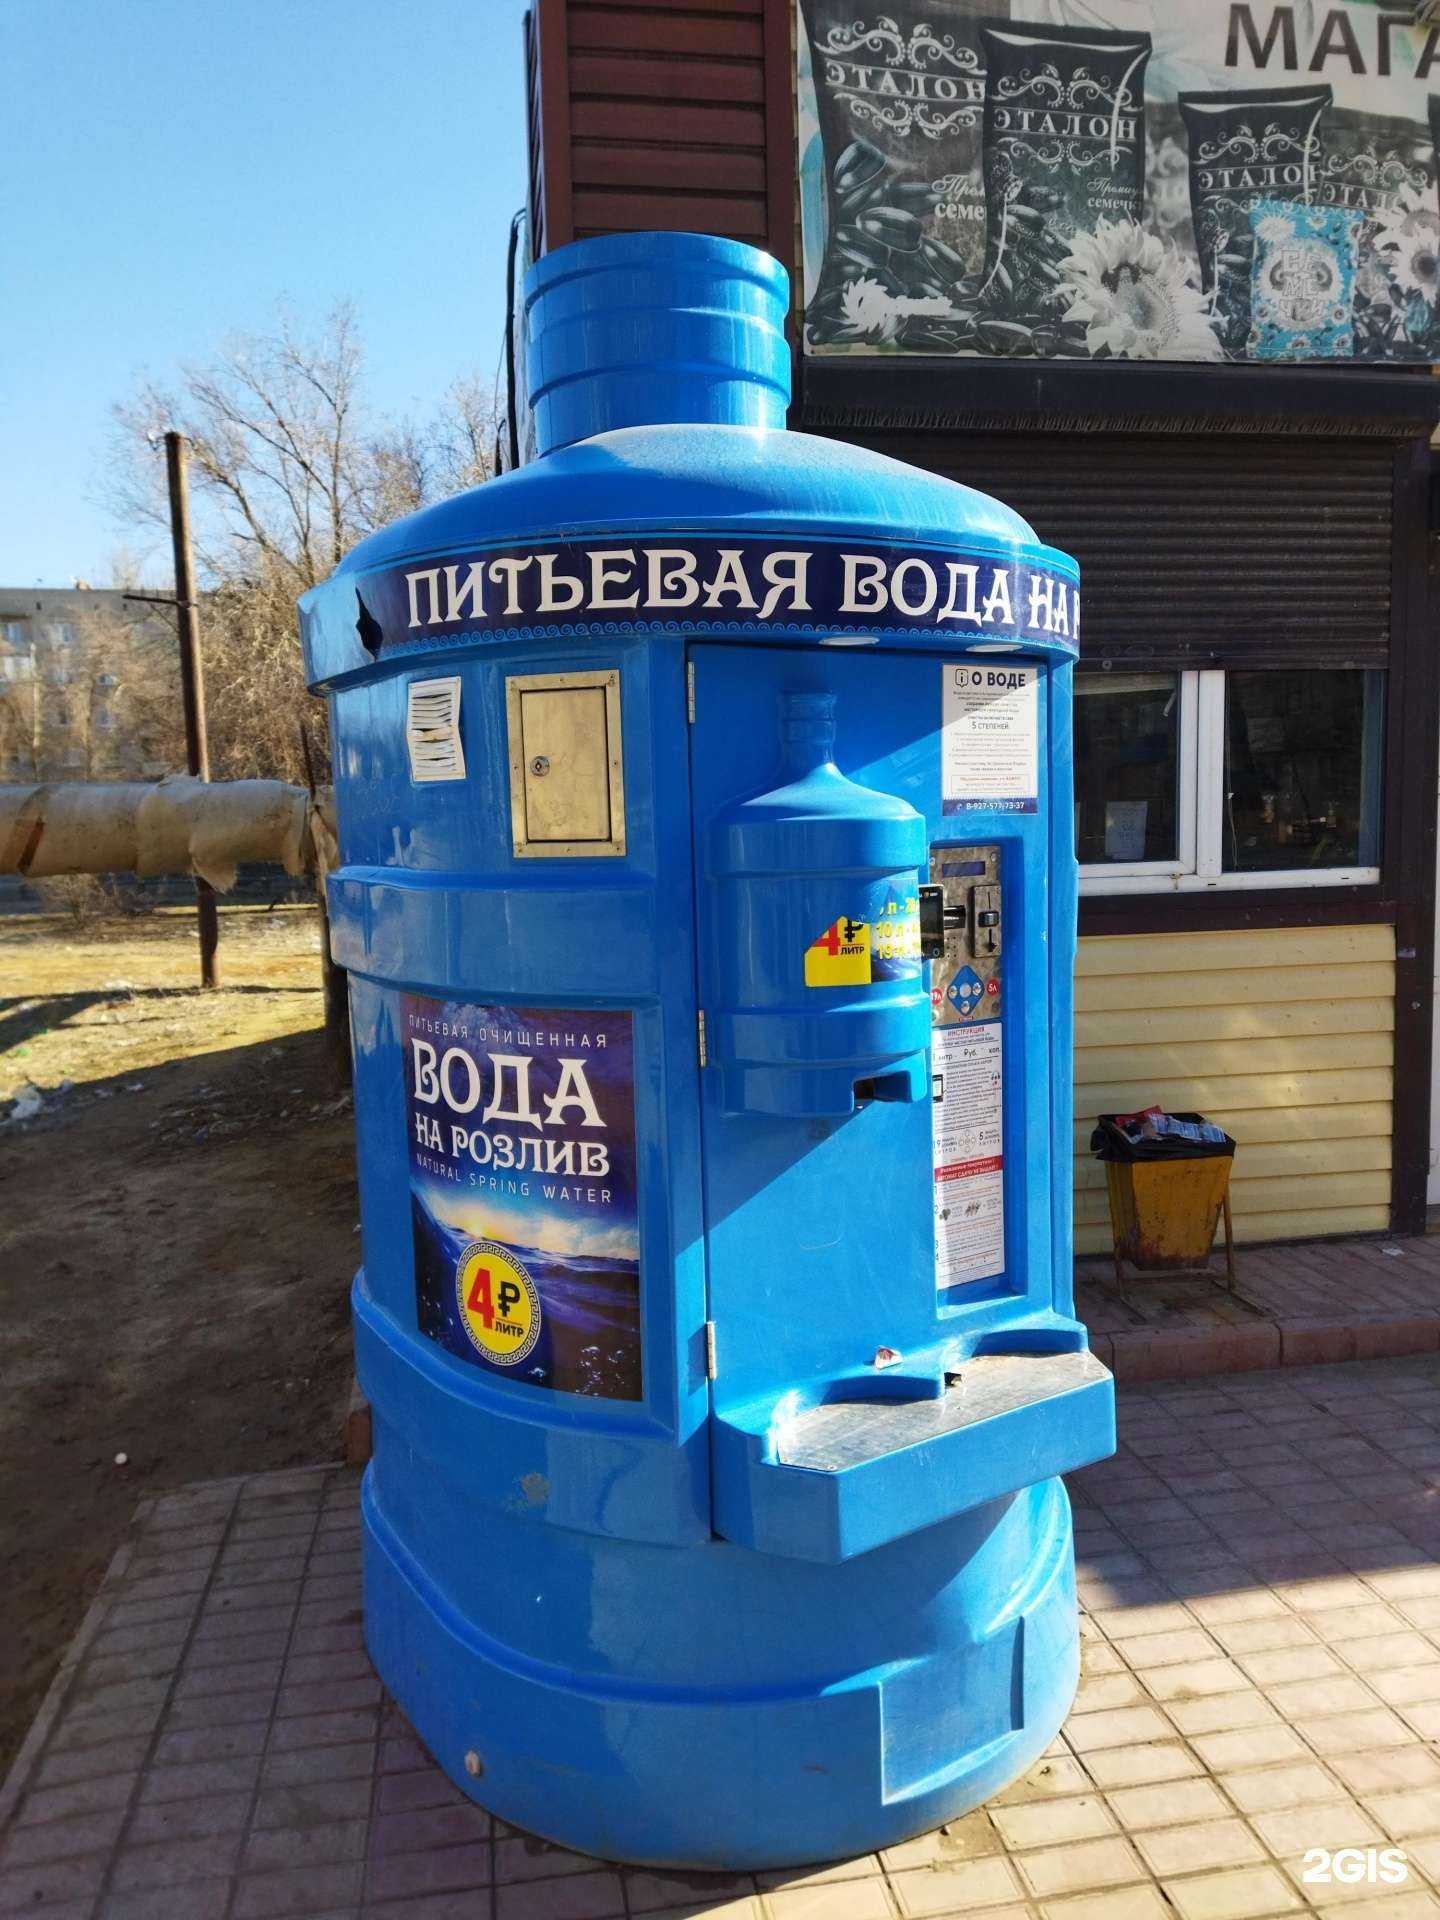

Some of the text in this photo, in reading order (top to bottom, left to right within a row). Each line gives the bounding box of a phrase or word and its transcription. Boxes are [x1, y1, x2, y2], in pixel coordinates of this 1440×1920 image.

[826, 61, 986, 100] ЭТАЛОН
[993, 108, 1136, 140] ЭТАЛОН
[405, 549, 813, 628] ПИТЬЕВАЯ
[838, 554, 1014, 627] ВОДА
[1028, 575, 1070, 636] НА
[972, 671, 1026, 689] О ВОДЕ
[840, 946, 864, 956] ЛИТР
[409, 1014, 607, 1048] ПИТЬЕВАЯ ОЧИЩЕННАЯ
[411, 1038, 607, 1132] ВОДА
[415, 1112, 610, 1177] НА РОЗЛИВ
[416, 1153, 611, 1203] NATURAL SPRING WATER
[495, 1322, 524, 1337] ЛИТР
